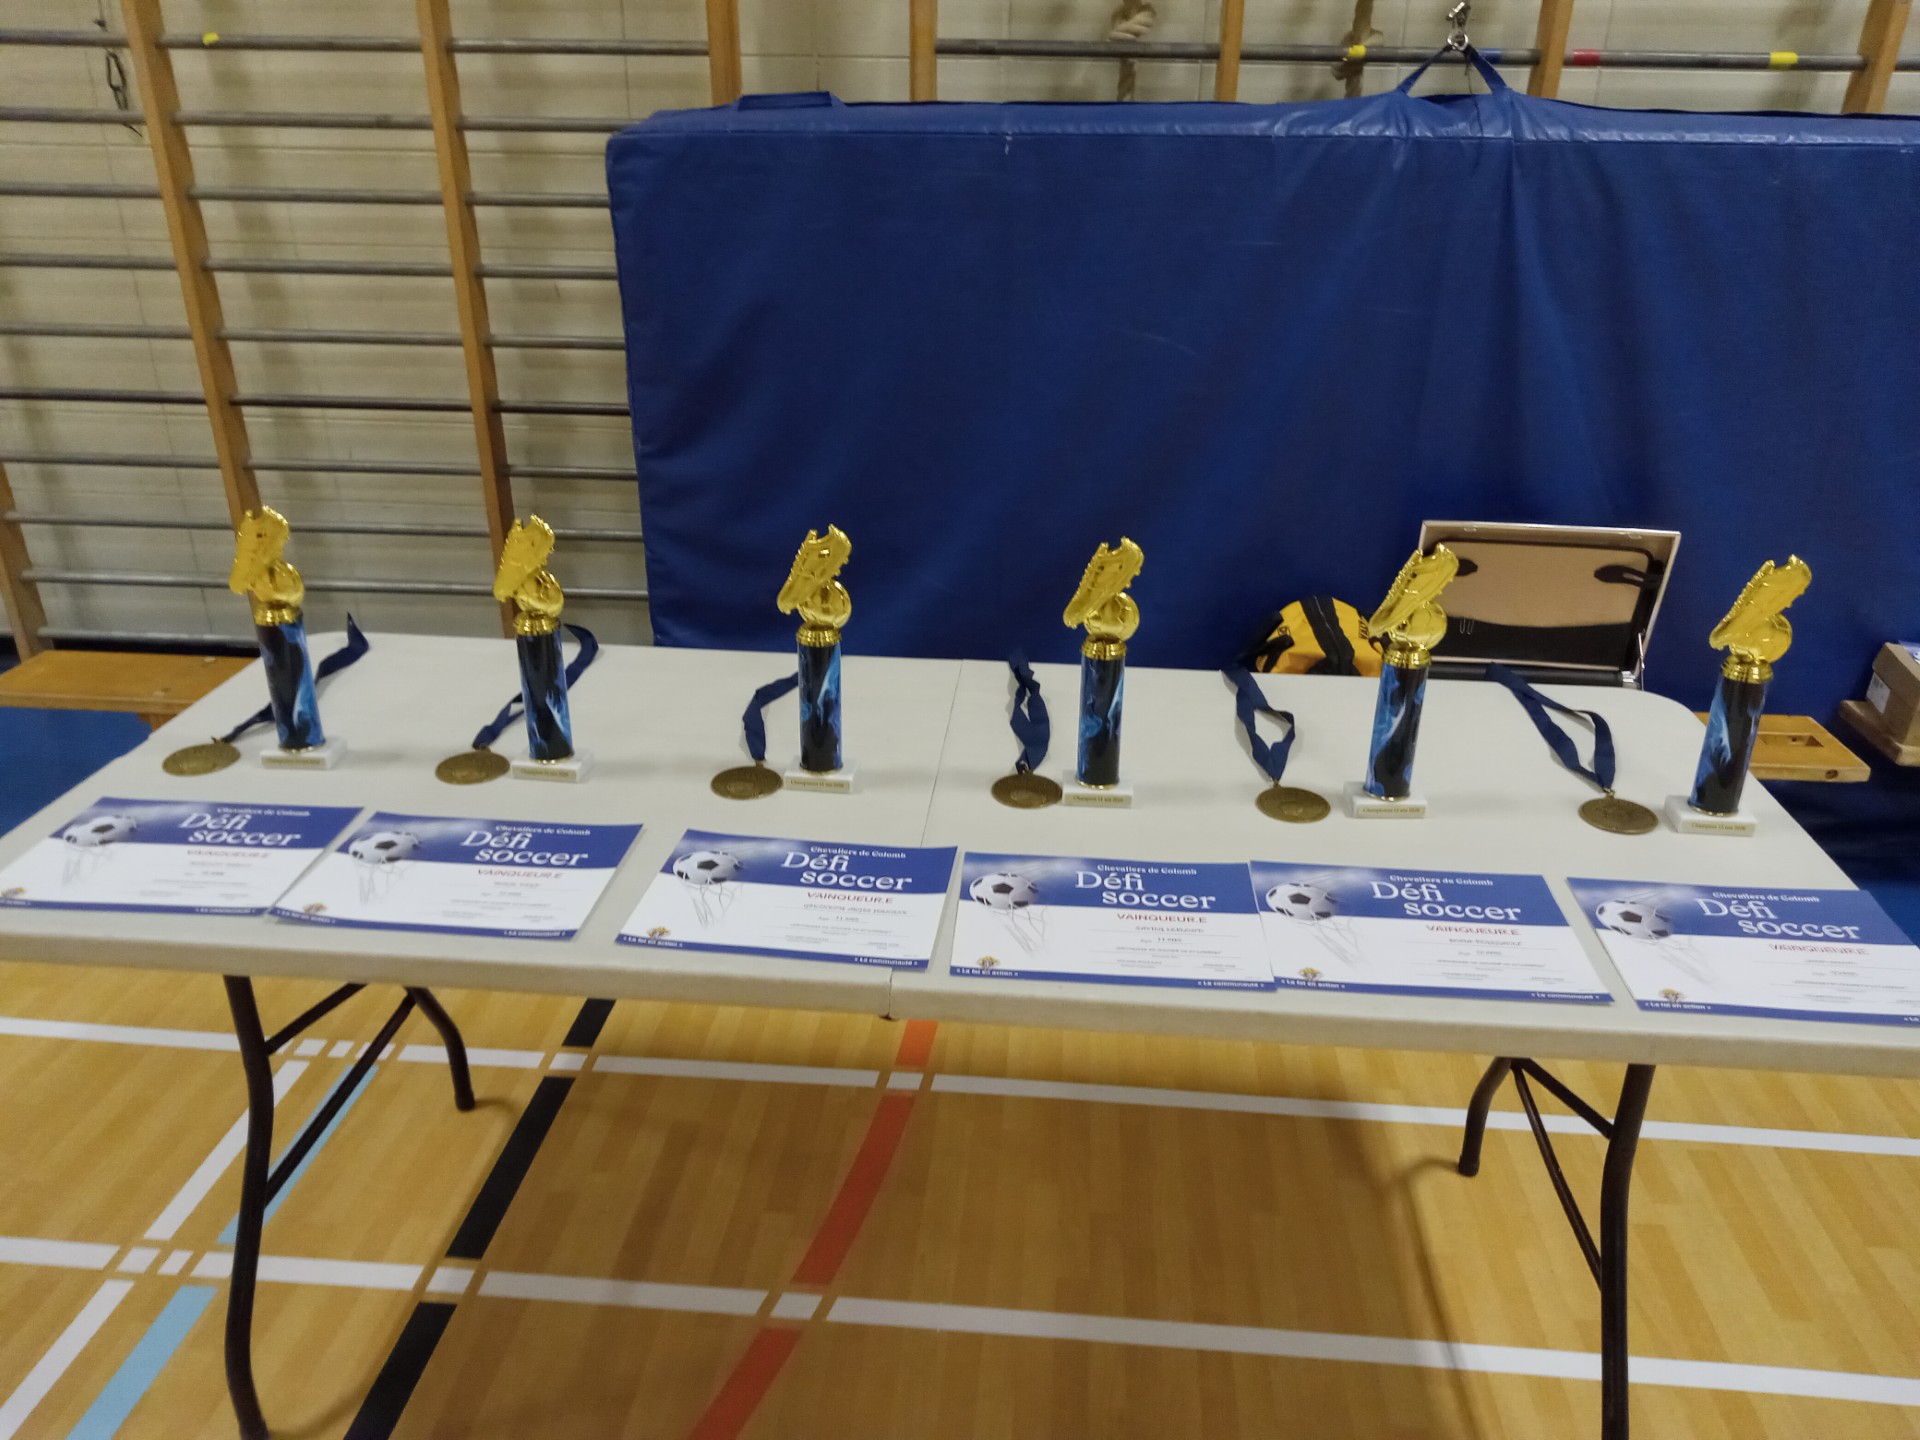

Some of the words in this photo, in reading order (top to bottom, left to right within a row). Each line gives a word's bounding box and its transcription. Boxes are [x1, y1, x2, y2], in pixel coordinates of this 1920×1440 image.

[178, 811, 252, 830] Défi
[188, 829, 301, 846] soccer
[460, 830, 533, 849] Défi
[474, 848, 589, 866] soccer
[781, 851, 850, 872] Défi
[810, 845, 857, 856] Chevaliers
[859, 849, 870, 857] de
[872, 851, 906, 860] Colomb
[1097, 864, 1146, 874] Chevaliers
[1148, 866, 1159, 874] de
[1160, 867, 1197, 876] Colomb
[800, 871, 913, 891] soccer
[1075, 870, 1144, 891] Défi
[1389, 874, 1441, 884] Chevaliers
[1442, 877, 1454, 885] de
[1455, 878, 1493, 887] Colomb
[806, 891, 895, 904] VAINQUEUR.E
[1102, 890, 1217, 910] soccer
[1369, 880, 1446, 902] Défi
[1713, 891, 1766, 902] Chevaliers
[1768, 894, 1779, 902] de
[1780, 894, 1820, 904] Colomb
[1117, 912, 1208, 924] VAINQUEUR.E
[1403, 902, 1522, 921] soccer
[1694, 897, 1779, 920] Défi
[1738, 919, 1861, 940] soccer
